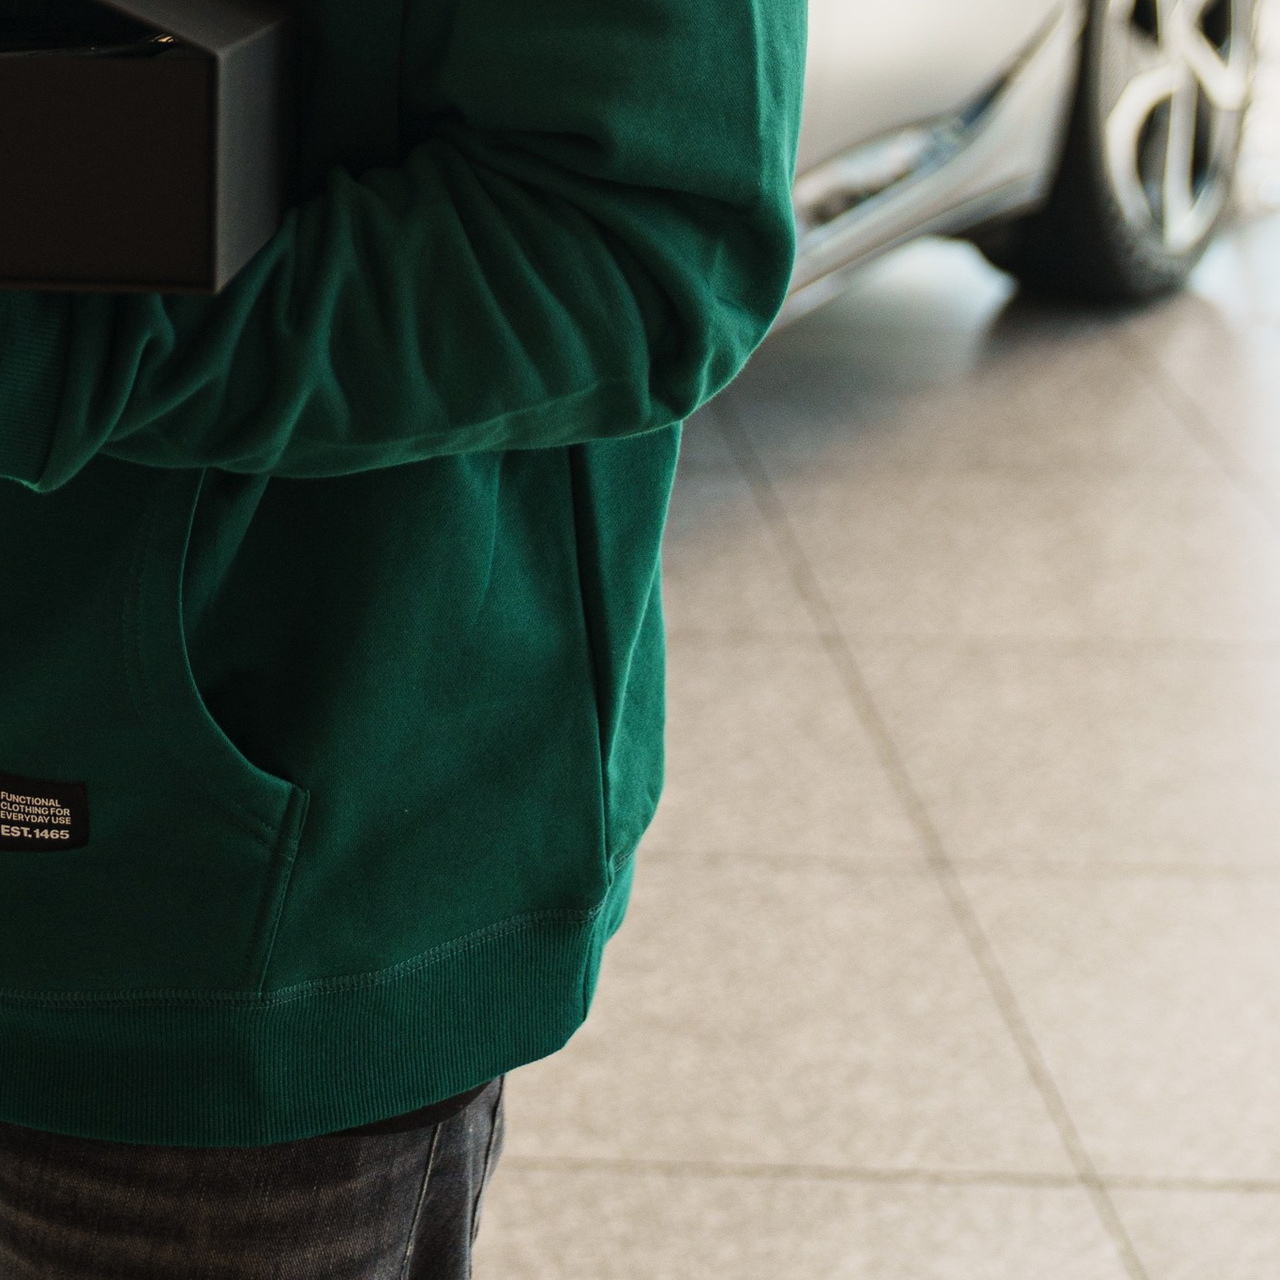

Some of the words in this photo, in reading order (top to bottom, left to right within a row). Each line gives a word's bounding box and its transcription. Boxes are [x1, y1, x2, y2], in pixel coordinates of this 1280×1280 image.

[0, 791, 61, 807] FUNCTIONAL
[0, 801, 49, 815] CLOTHING
[50, 807, 71, 816] FOR
[0, 811, 52, 824] EVERYDAY
[51, 816, 72, 825] USE
